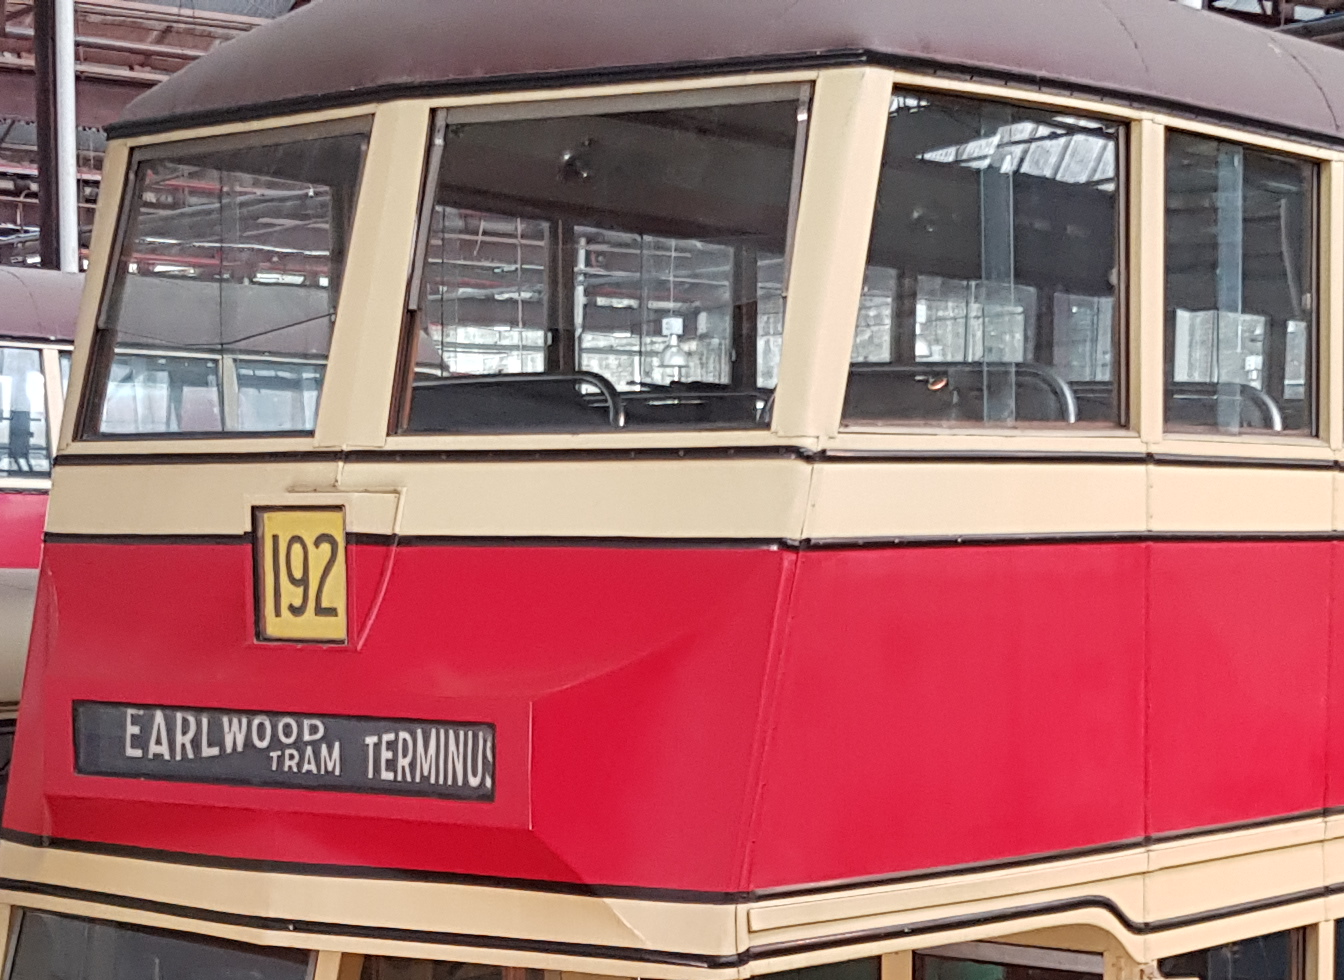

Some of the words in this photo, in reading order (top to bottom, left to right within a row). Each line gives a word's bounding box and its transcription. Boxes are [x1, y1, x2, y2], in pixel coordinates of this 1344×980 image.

[271, 533, 340, 618] 192
[124, 707, 325, 762] EARLWOOD
[269, 741, 342, 776] TRAM
